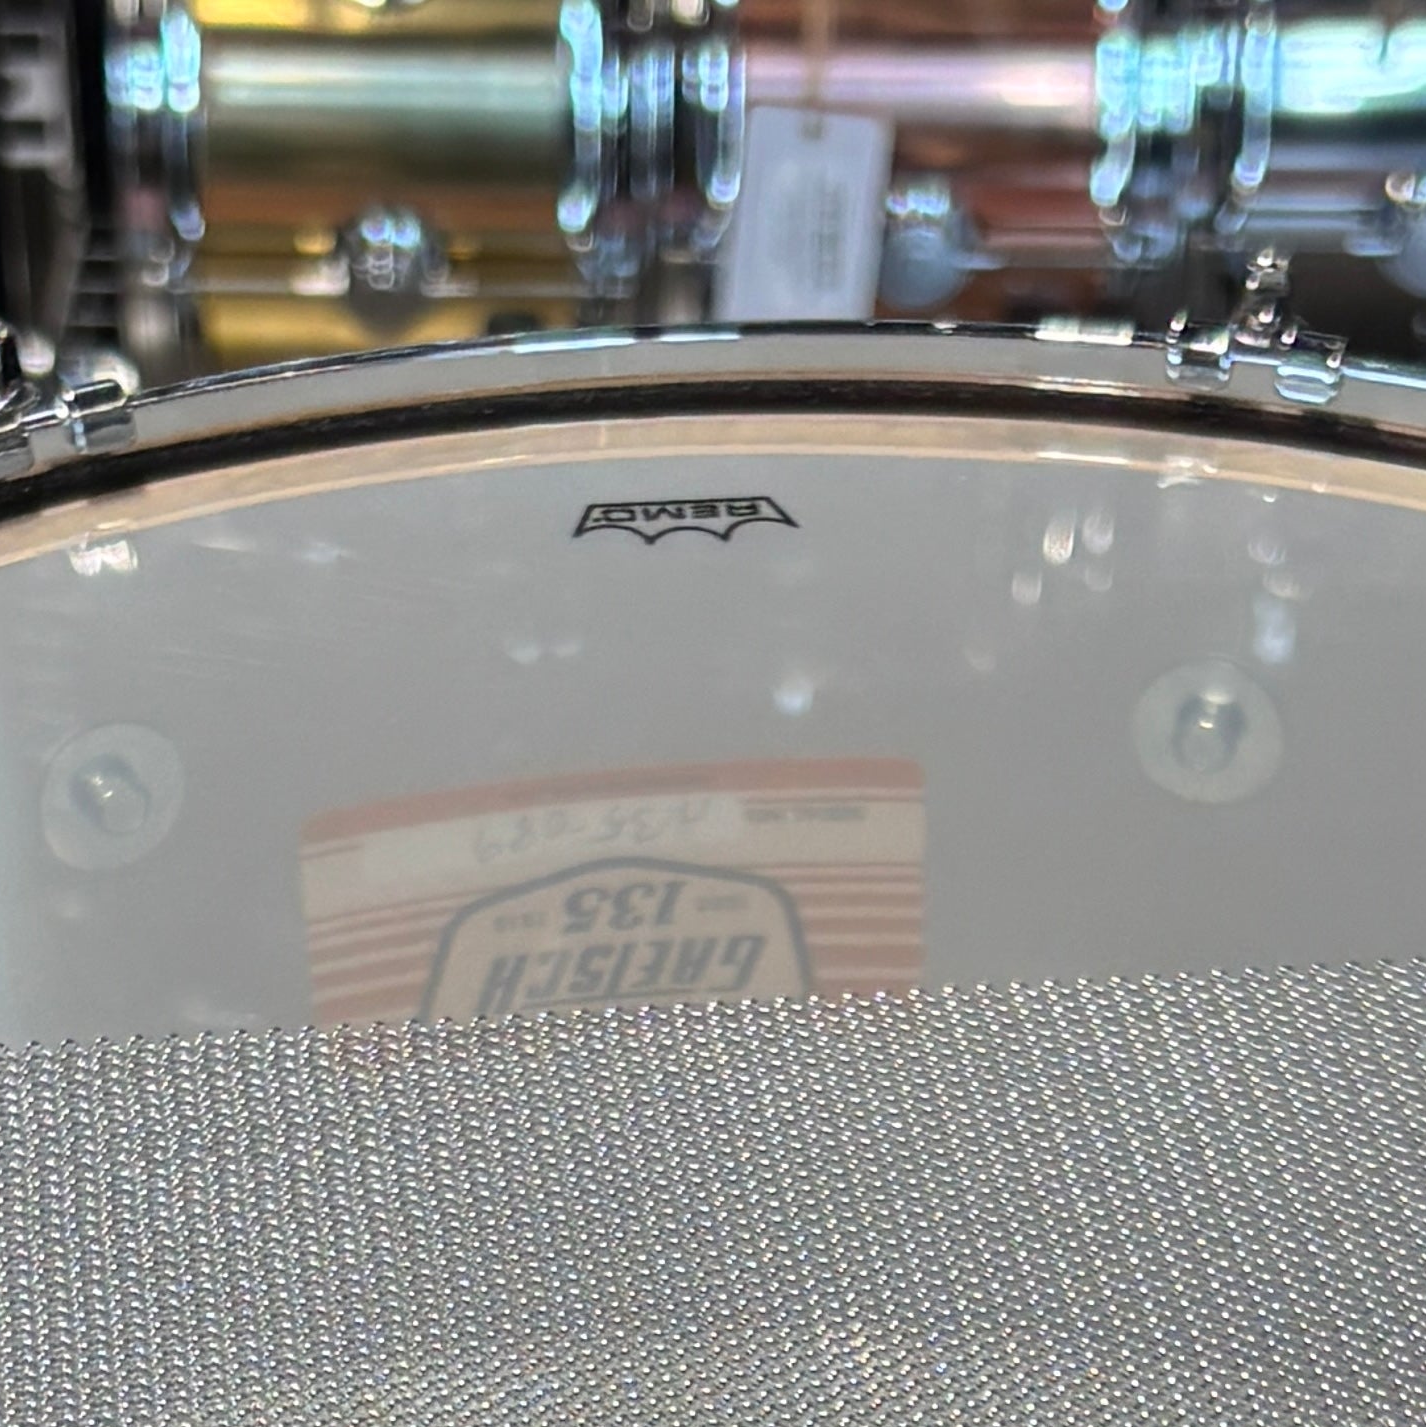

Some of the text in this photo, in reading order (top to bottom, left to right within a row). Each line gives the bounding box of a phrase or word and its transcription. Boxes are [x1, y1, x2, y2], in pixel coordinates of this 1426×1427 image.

[600, 503, 762, 523] REMO
[561, 879, 687, 935] 135
[477, 933, 766, 1013] GRETSCH
